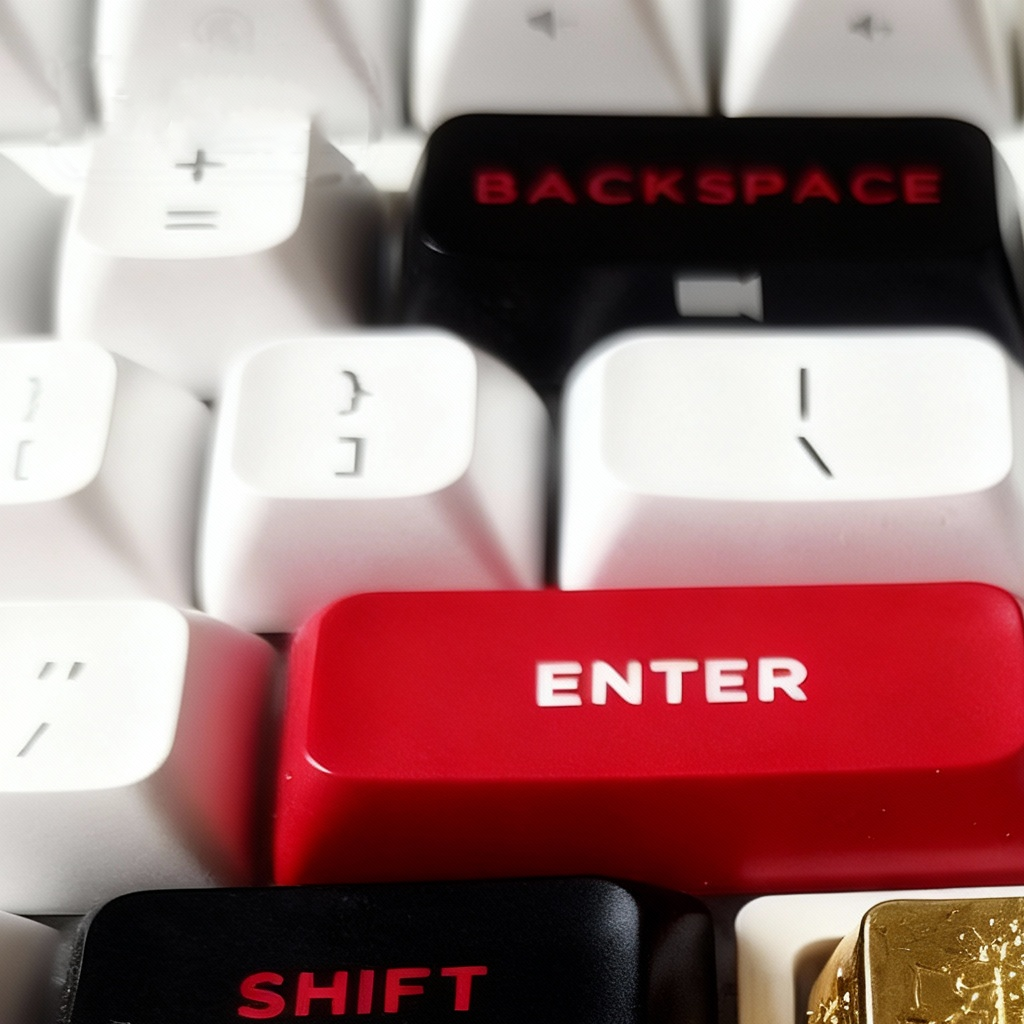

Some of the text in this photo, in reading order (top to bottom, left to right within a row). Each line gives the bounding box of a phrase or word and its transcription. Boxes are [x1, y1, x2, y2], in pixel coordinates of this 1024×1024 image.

[474, 167, 942, 205] BACKSPACE
[536, 656, 809, 709] ENTER
[236, 965, 489, 1020] SHIFT
